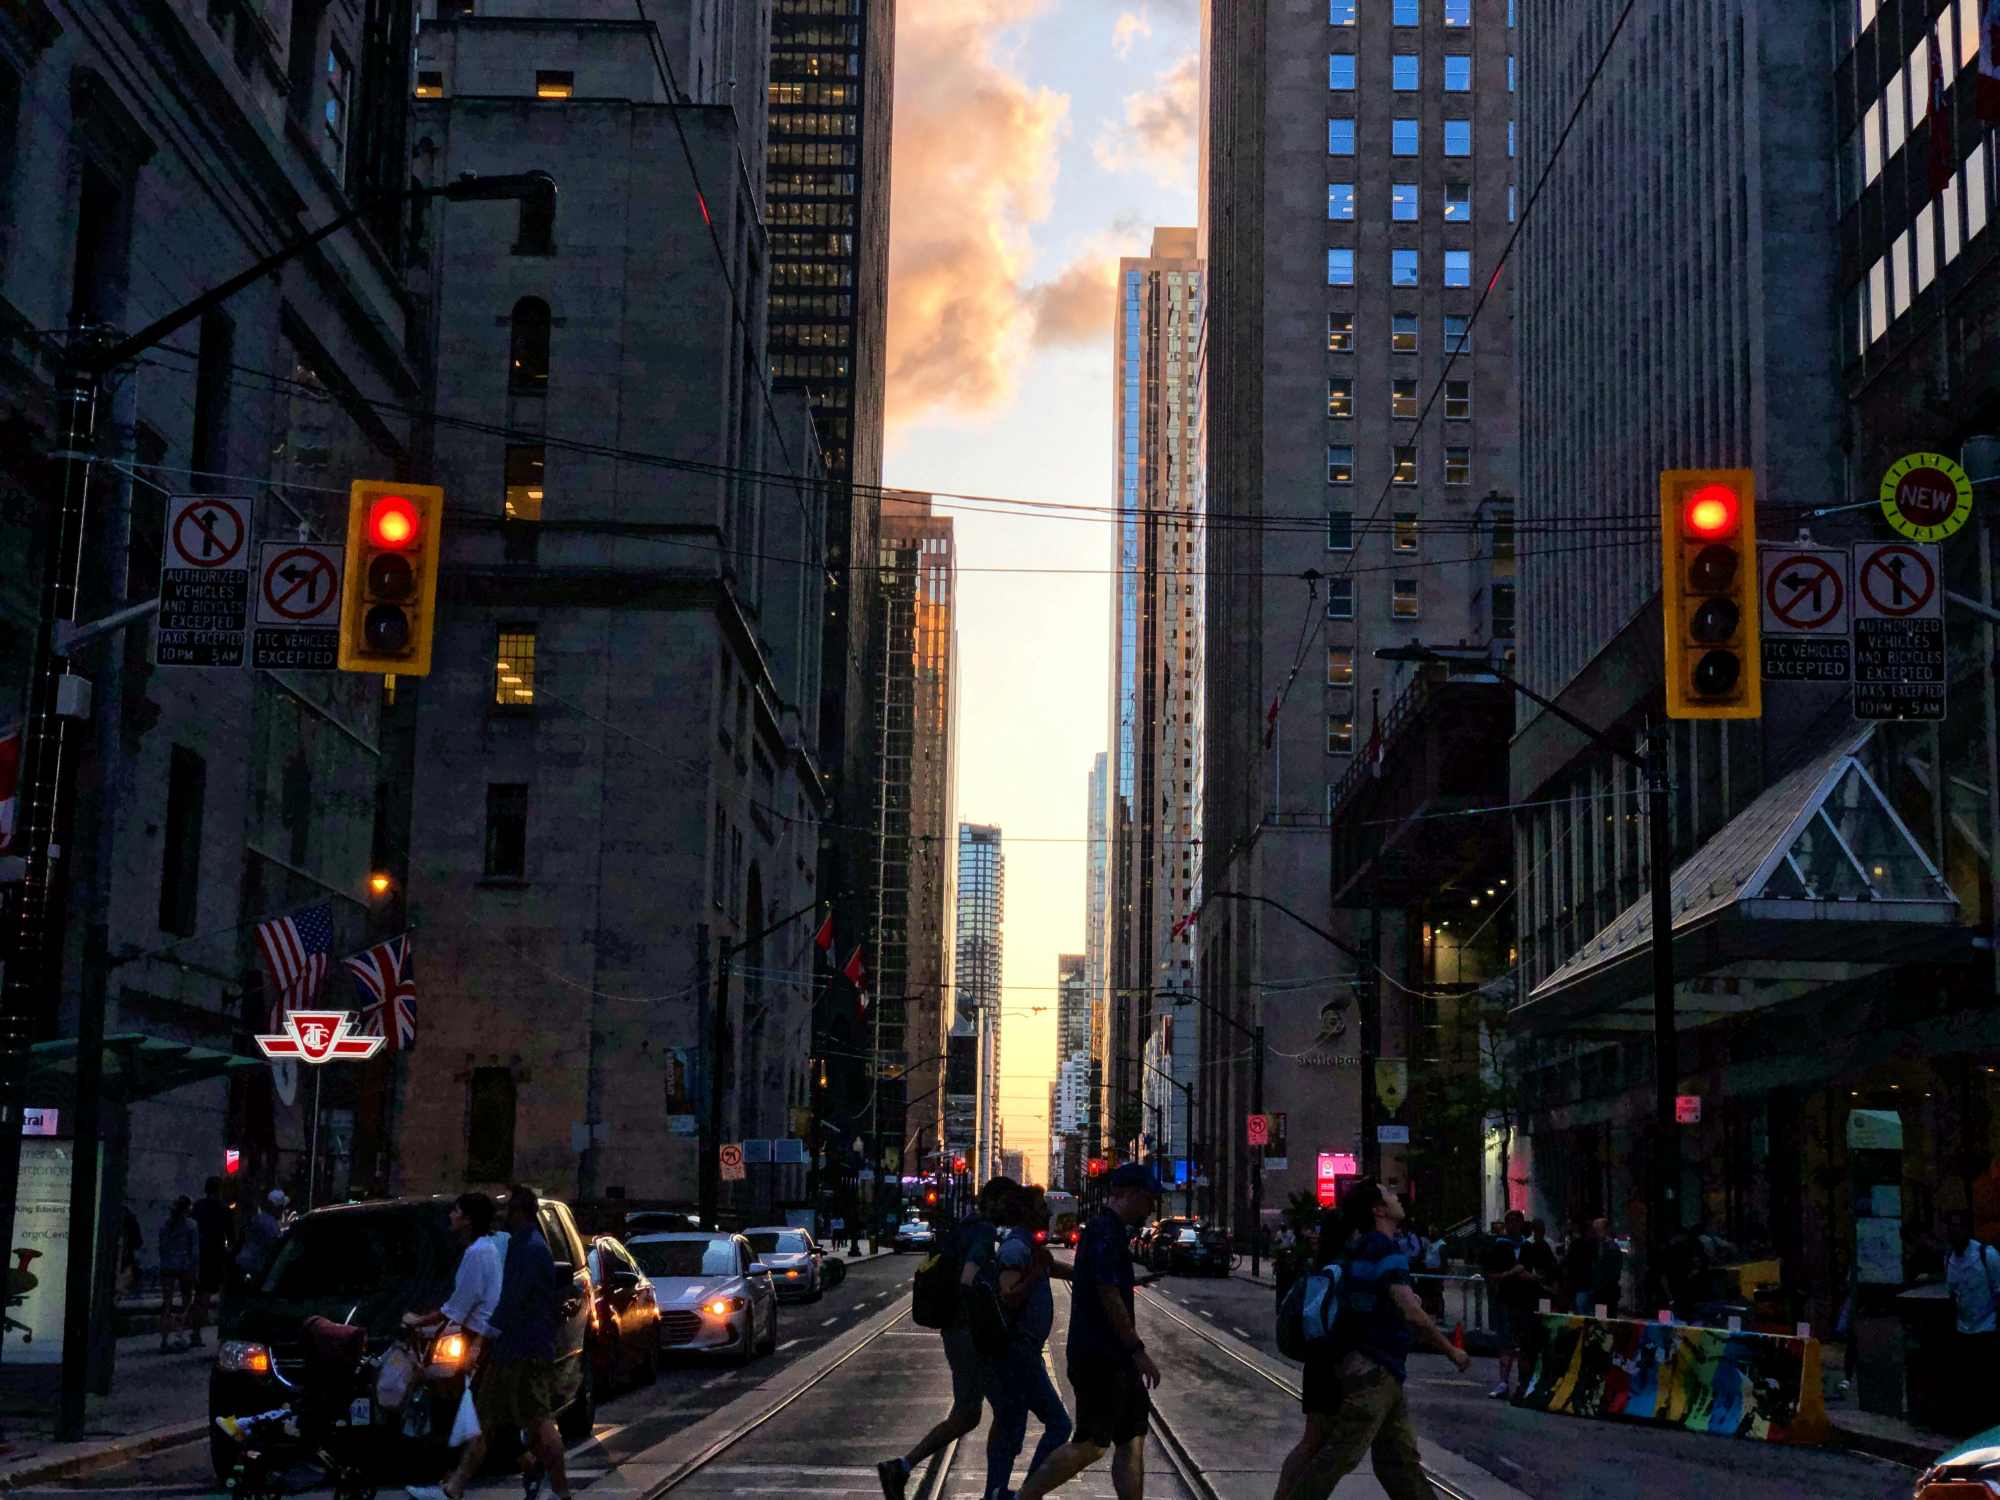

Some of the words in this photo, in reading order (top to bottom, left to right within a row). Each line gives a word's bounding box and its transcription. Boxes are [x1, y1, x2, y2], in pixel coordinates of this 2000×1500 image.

[1900, 484, 1952, 513] NEW
[166, 569, 247, 583] AUTHORIZED
[175, 585, 235, 599] VEHICLES
[162, 600, 187, 613] AND
[191, 600, 246, 614] BICYCLES
[170, 615, 235, 629] EXCEPTED
[1858, 620, 1940, 633] AUTHORIZED
[159, 631, 188, 645] TAXIS
[194, 631, 245, 646] EXCEPTED
[256, 633, 281, 647] TTC
[285, 634, 338, 648] VEHICLES
[1868, 635, 1930, 649] VEHICLES
[258, 650, 334, 665] EXCEPTED
[1764, 643, 1788, 657] TTC
[1792, 645, 1849, 659] VEHICLES
[1857, 651, 1881, 664] AND
[1887, 650, 1943, 665] BICYCLES
[1767, 661, 1845, 676] EXCEPTED
[1866, 666, 1933, 680] EXCEPTED
[1856, 685, 1885, 698] TAXIS
[1891, 684, 1944, 698] EXCEPTED
[1297, 1055, 1361, 1066] Scotiaban
